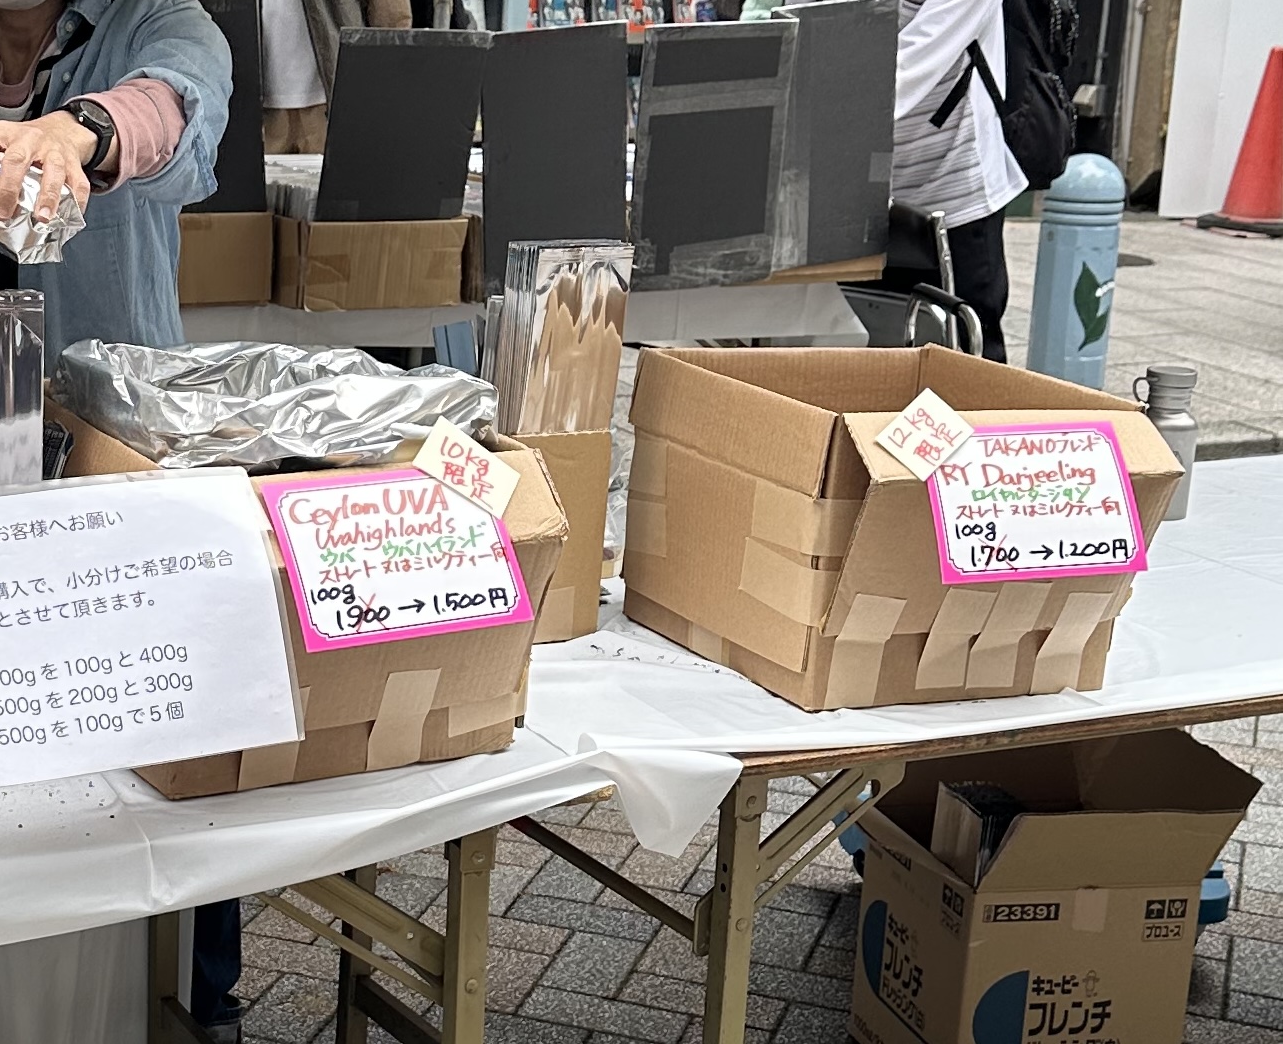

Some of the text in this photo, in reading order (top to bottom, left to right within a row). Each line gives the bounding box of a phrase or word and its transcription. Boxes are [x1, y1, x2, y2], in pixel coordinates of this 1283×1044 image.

[938, 460, 1097, 492] RY Darjeeling
[288, 483, 450, 530] Ceylon UVA
[955, 521, 998, 541] 100g
[310, 583, 356, 605] 100g
[995, 905, 1057, 921] 23391
[1144, 924, 1182, 939] プロユース
[1031, 975, 1080, 996] キューピー
[1028, 999, 1112, 1037] フレンチ
